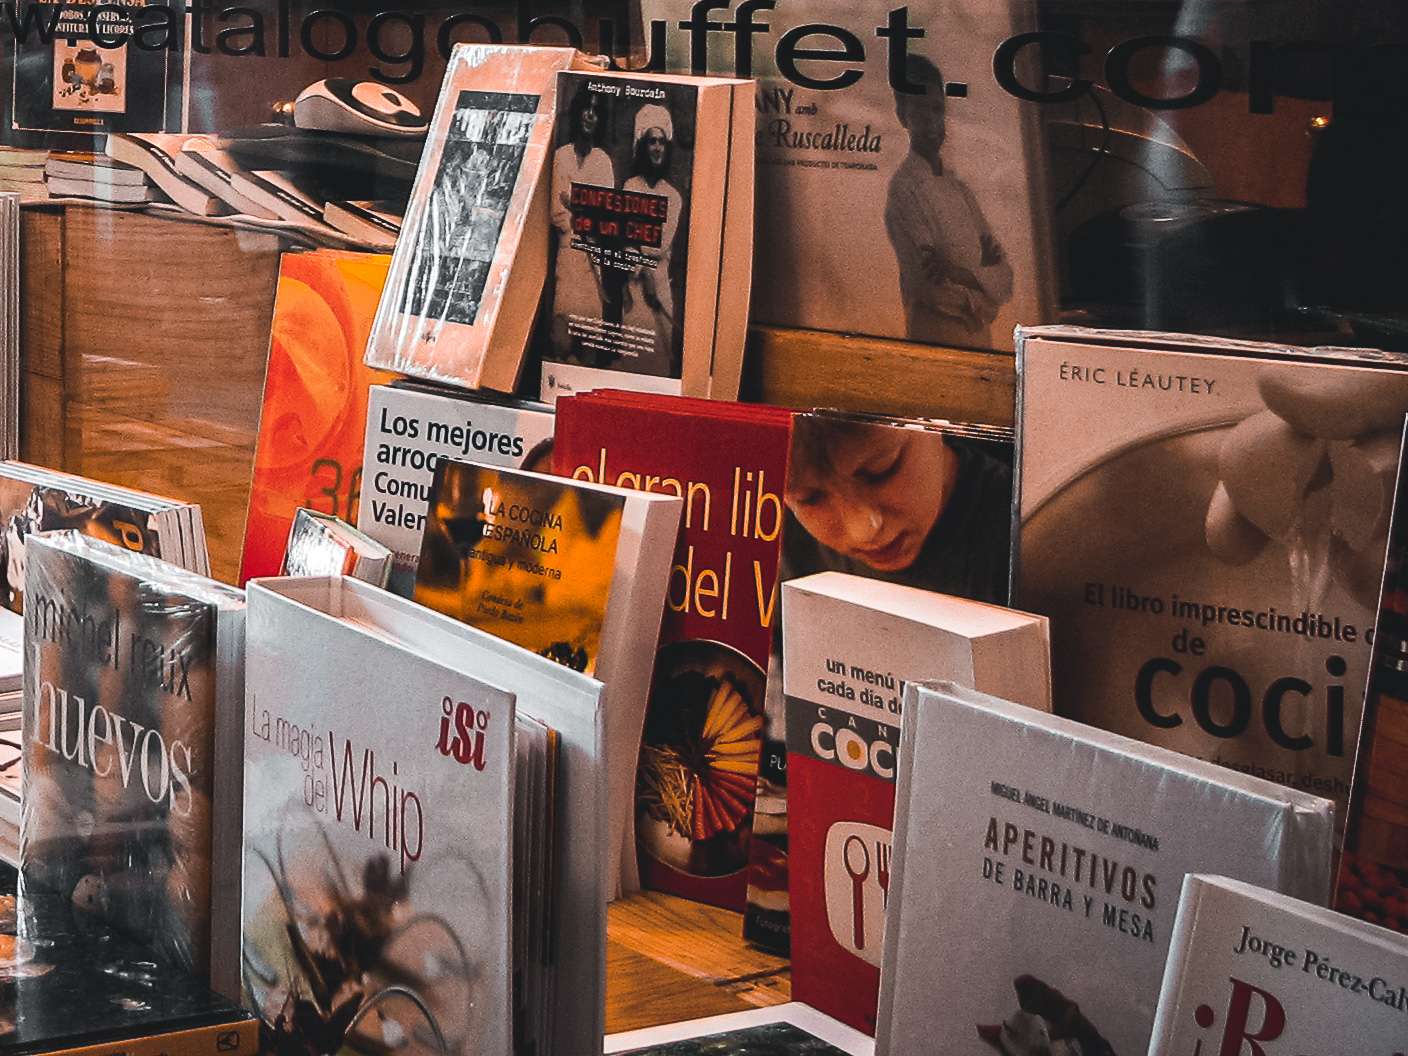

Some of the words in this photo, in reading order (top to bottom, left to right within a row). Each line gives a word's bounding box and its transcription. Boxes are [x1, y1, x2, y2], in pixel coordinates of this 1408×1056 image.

[587, 81, 621, 97] Anthony
[625, 85, 666, 100] Bourdain
[795, 104, 818, 116] amb
[769, 120, 882, 154] Ruscalleda
[572, 187, 668, 219] CONFESIONES
[575, 217, 591, 231] de
[599, 221, 619, 235] un
[626, 222, 662, 243] CHEF
[1059, 360, 1106, 386] ÉRIC
[1117, 366, 1217, 396] LÉAUTEY
[380, 407, 419, 439] Los
[427, 420, 524, 458] mejores
[377, 440, 460, 473] arroc
[488, 499, 506, 518] LA
[509, 506, 564, 532] COCINA
[616, 469, 711, 532] gran
[486, 521, 558, 555] ESPAÑOLA
[469, 548, 507, 569] antigua
[517, 557, 562, 581] moderna
[670, 551, 732, 620] del
[1111, 587, 1165, 615] libro
[1171, 594, 1357, 645] imprescindible
[1171, 628, 1206, 657] de
[817, 677, 855, 701] cada
[826, 657, 846, 676] un
[850, 661, 895, 691] menú
[1135, 655, 1348, 757] coci
[33, 642, 194, 818] huevos
[252, 693, 271, 743] La
[275, 716, 325, 773] magia
[303, 770, 328, 816] del
[327, 730, 425, 876] Whip
[1096, 817, 1111, 834] DE
[983, 817, 1157, 910] APERITIVOS
[982, 857, 1005, 885] DE
[1013, 868, 1073, 912] BARRA
[1083, 895, 1093, 918] Y
[1102, 903, 1154, 943] MESA
[1234, 925, 1296, 969] Jorge
